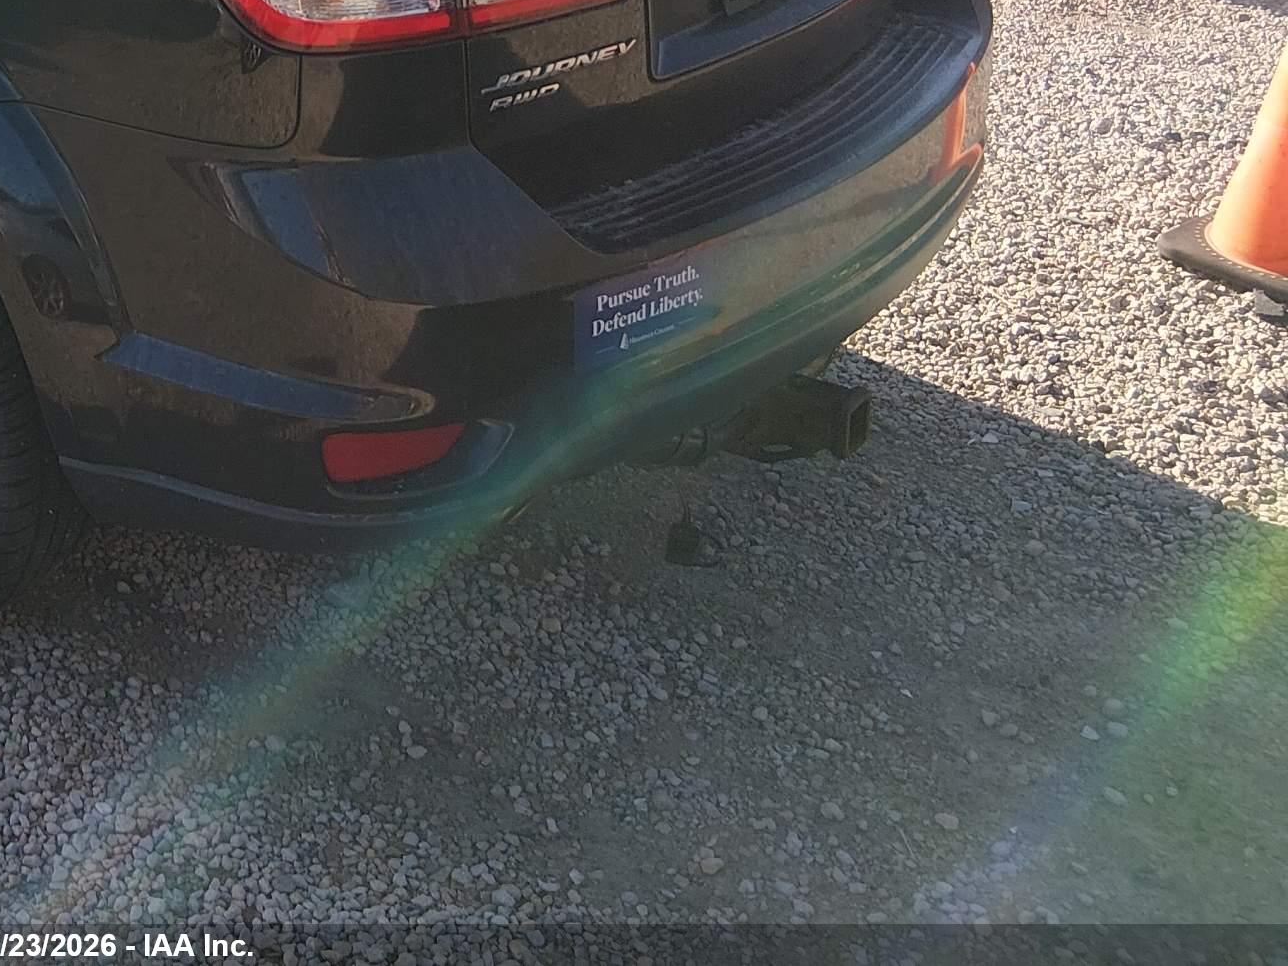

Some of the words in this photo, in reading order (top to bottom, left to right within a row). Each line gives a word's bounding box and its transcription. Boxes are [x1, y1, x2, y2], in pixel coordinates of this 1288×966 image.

[481, 39, 638, 94] JOURNEY
[596, 283, 651, 312] Pursue
[653, 265, 700, 292] Truth.
[592, 304, 646, 337] Defend
